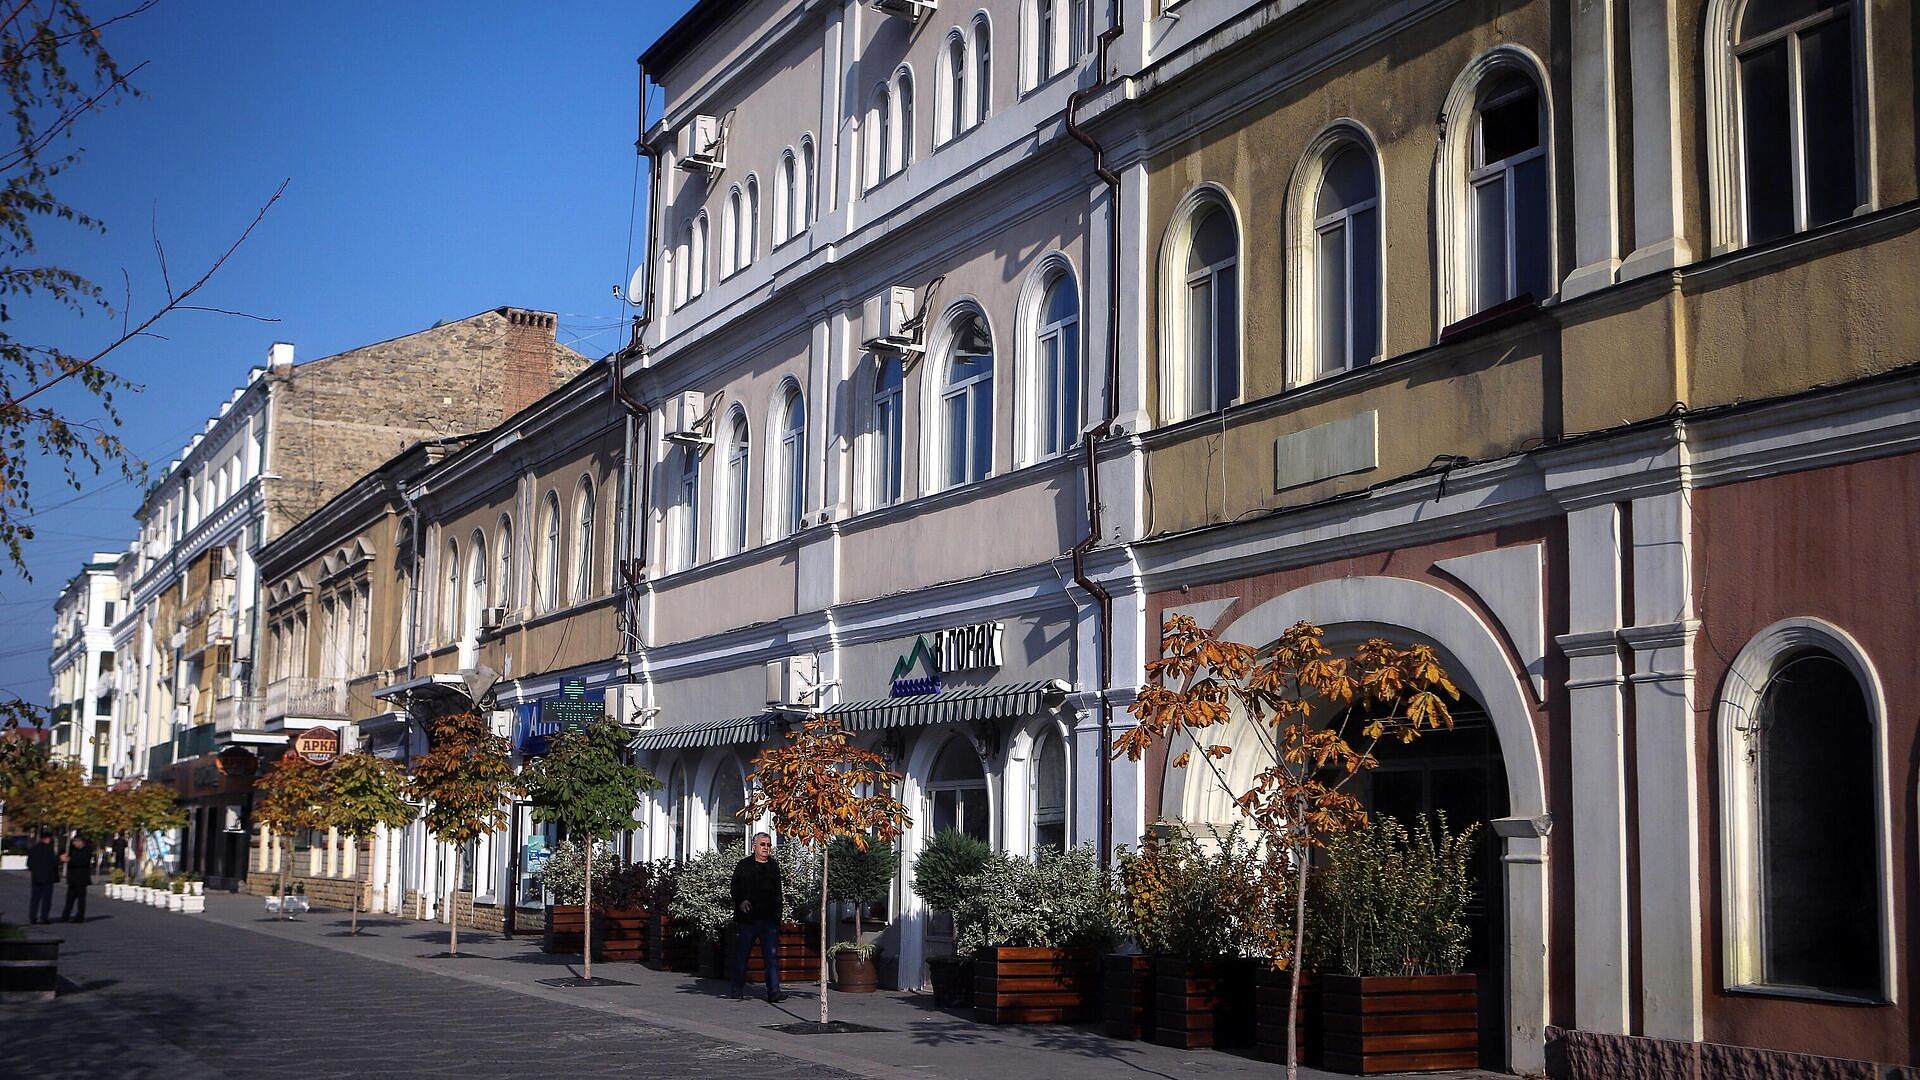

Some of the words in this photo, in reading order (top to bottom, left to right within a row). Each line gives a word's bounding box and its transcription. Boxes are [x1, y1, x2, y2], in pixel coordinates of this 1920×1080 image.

[935, 630, 948, 673] В
[948, 619, 1004, 673] ГОРАХ
[302, 740, 336, 752] АРКА
